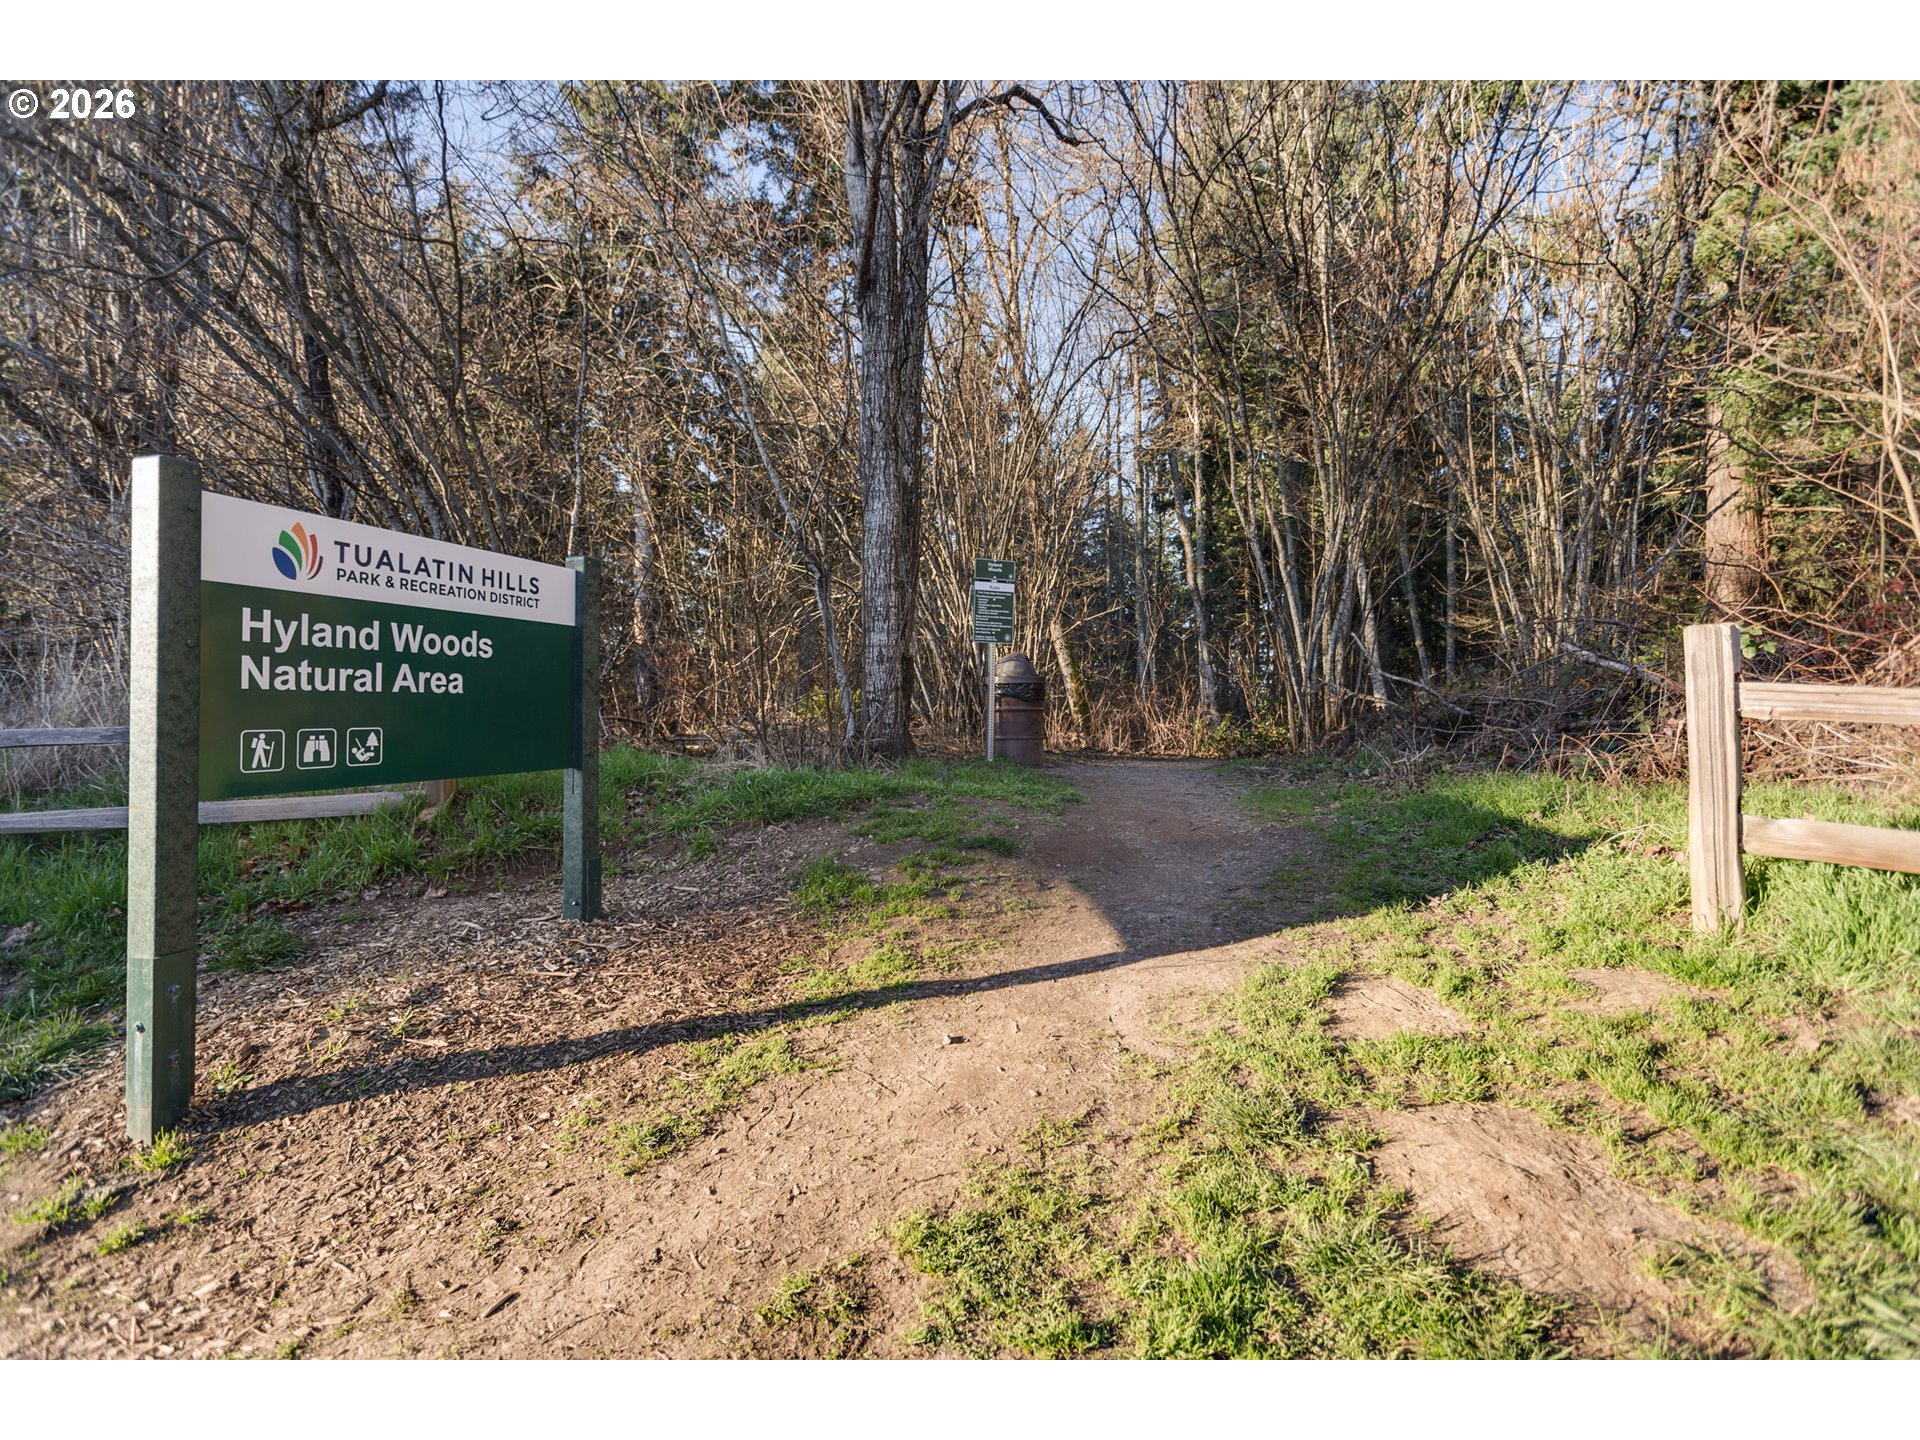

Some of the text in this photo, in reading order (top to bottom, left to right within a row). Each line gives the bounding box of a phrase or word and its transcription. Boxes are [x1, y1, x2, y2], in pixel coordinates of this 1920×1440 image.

[334, 540, 540, 595] TUALATIN HILLS
[336, 567, 540, 609] PARK & RECREATION DISTRICT
[241, 606, 494, 659] Hyland Woods
[240, 654, 464, 694] Natural Area
